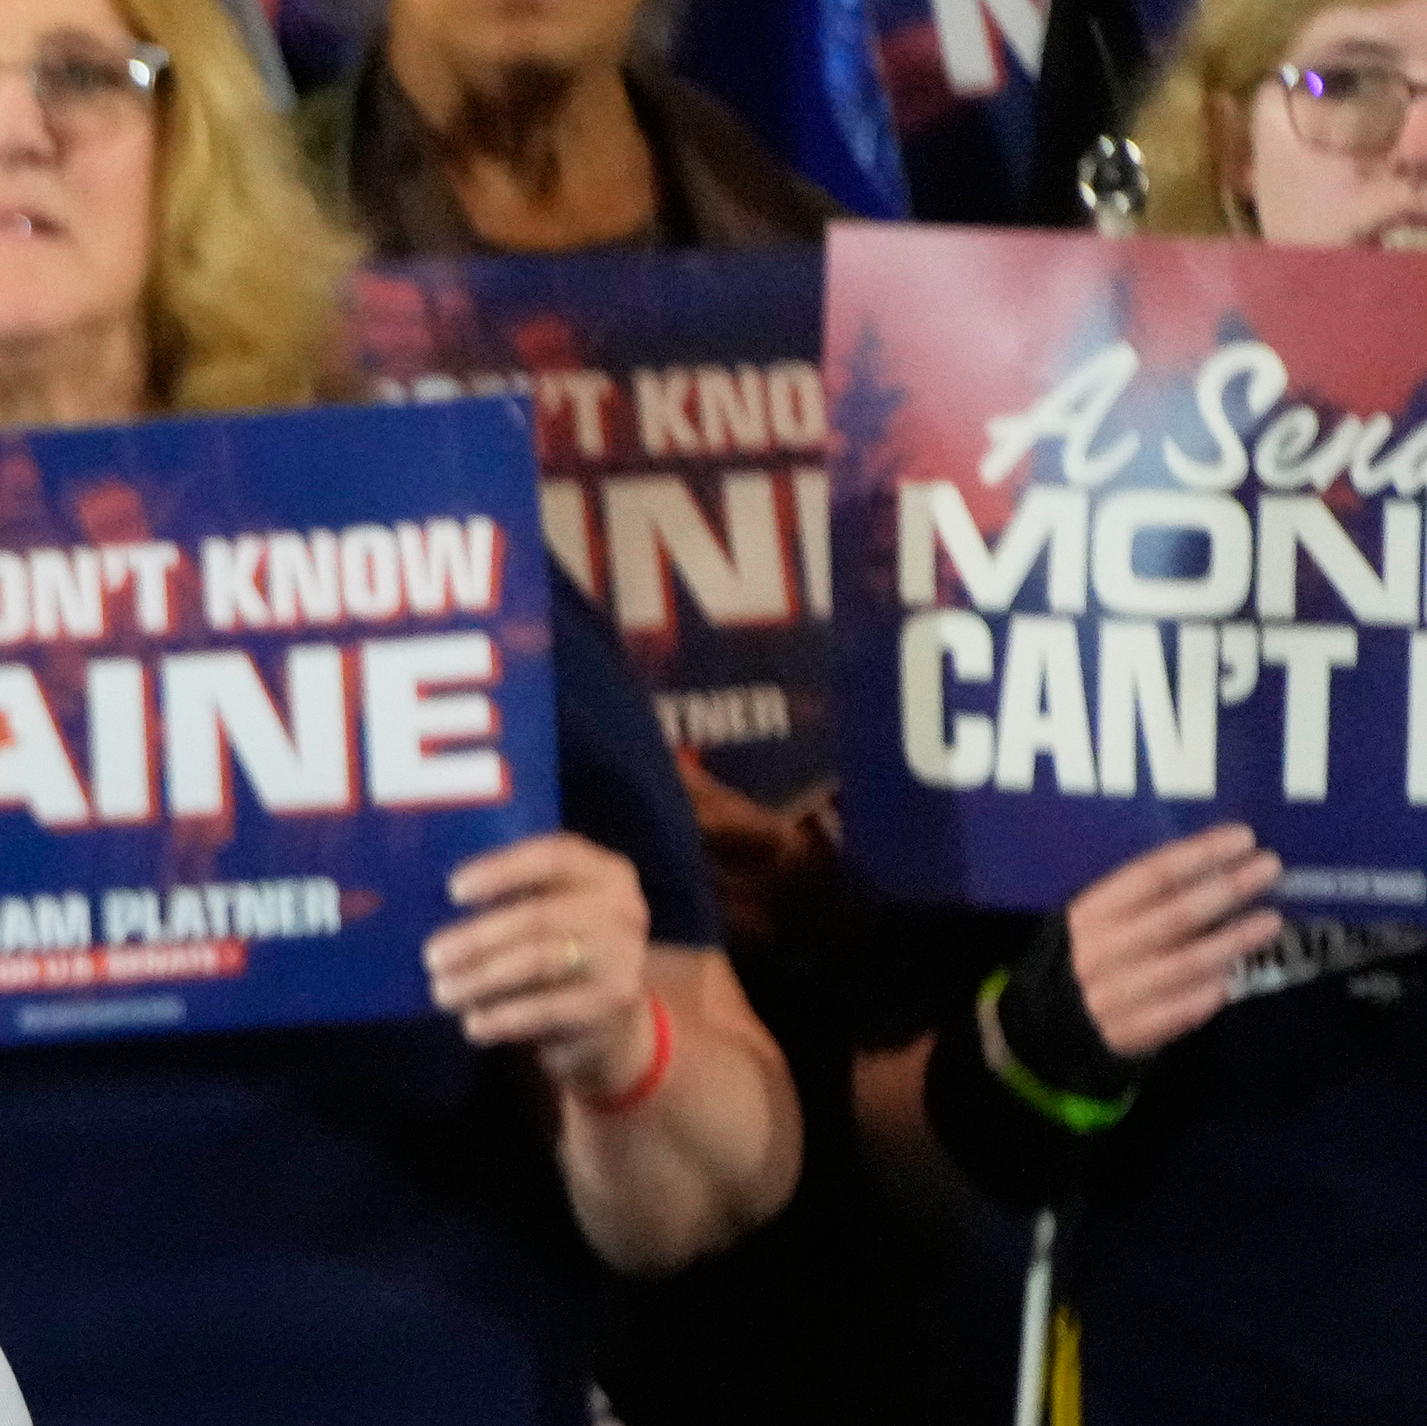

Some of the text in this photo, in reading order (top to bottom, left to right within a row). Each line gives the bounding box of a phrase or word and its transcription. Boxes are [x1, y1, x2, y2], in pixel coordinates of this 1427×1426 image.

[978, 340, 1142, 487] A
[200, 515, 497, 633] KNOW
[899, 610, 1359, 804] CAN'T
[99, 876, 343, 947] PLATNER
